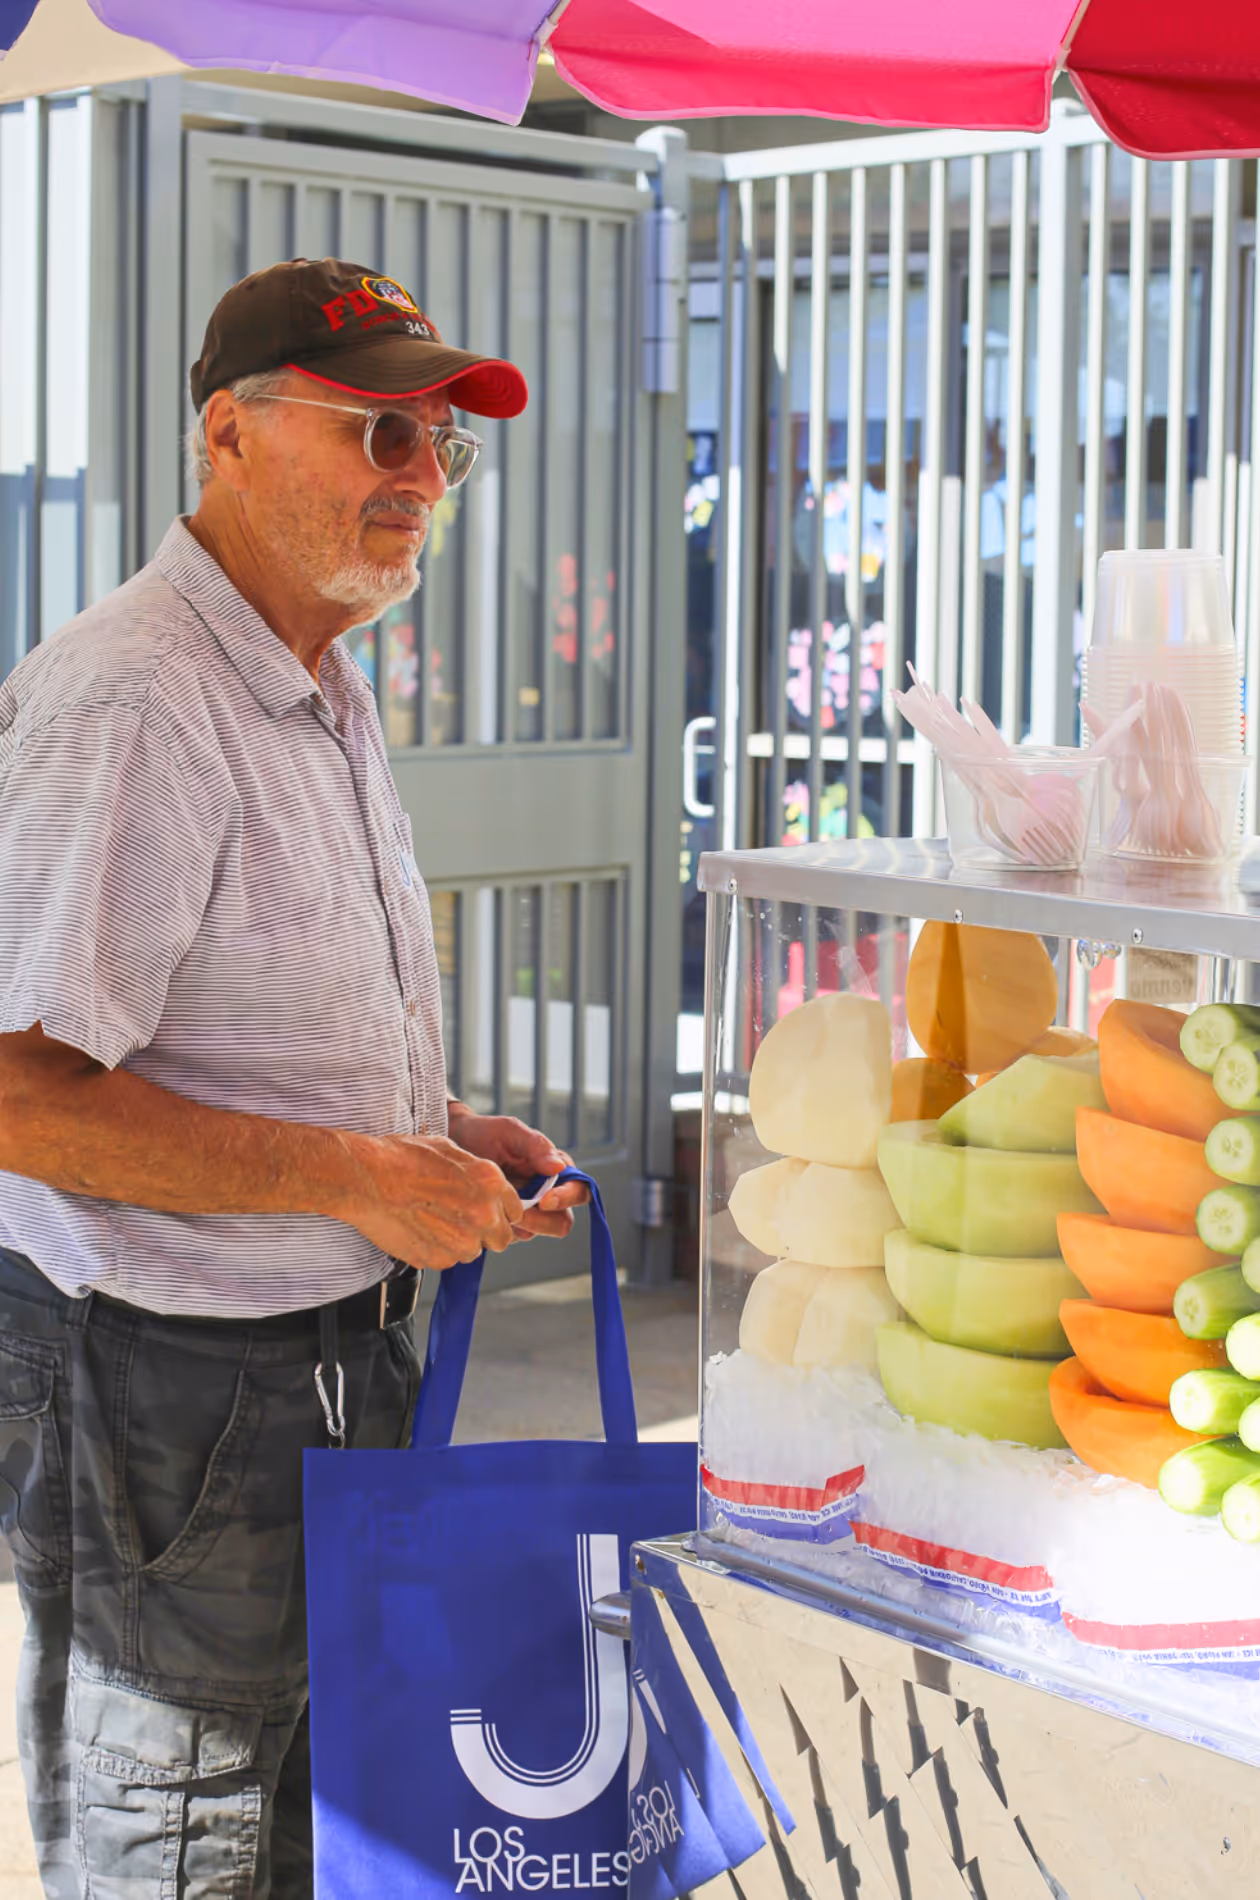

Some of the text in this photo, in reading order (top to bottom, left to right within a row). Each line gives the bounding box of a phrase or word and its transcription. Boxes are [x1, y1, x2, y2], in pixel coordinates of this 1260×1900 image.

[405, 321, 430, 336] 343
[453, 1826, 526, 1864] LOS
[454, 1851, 629, 1894] ANGELES
